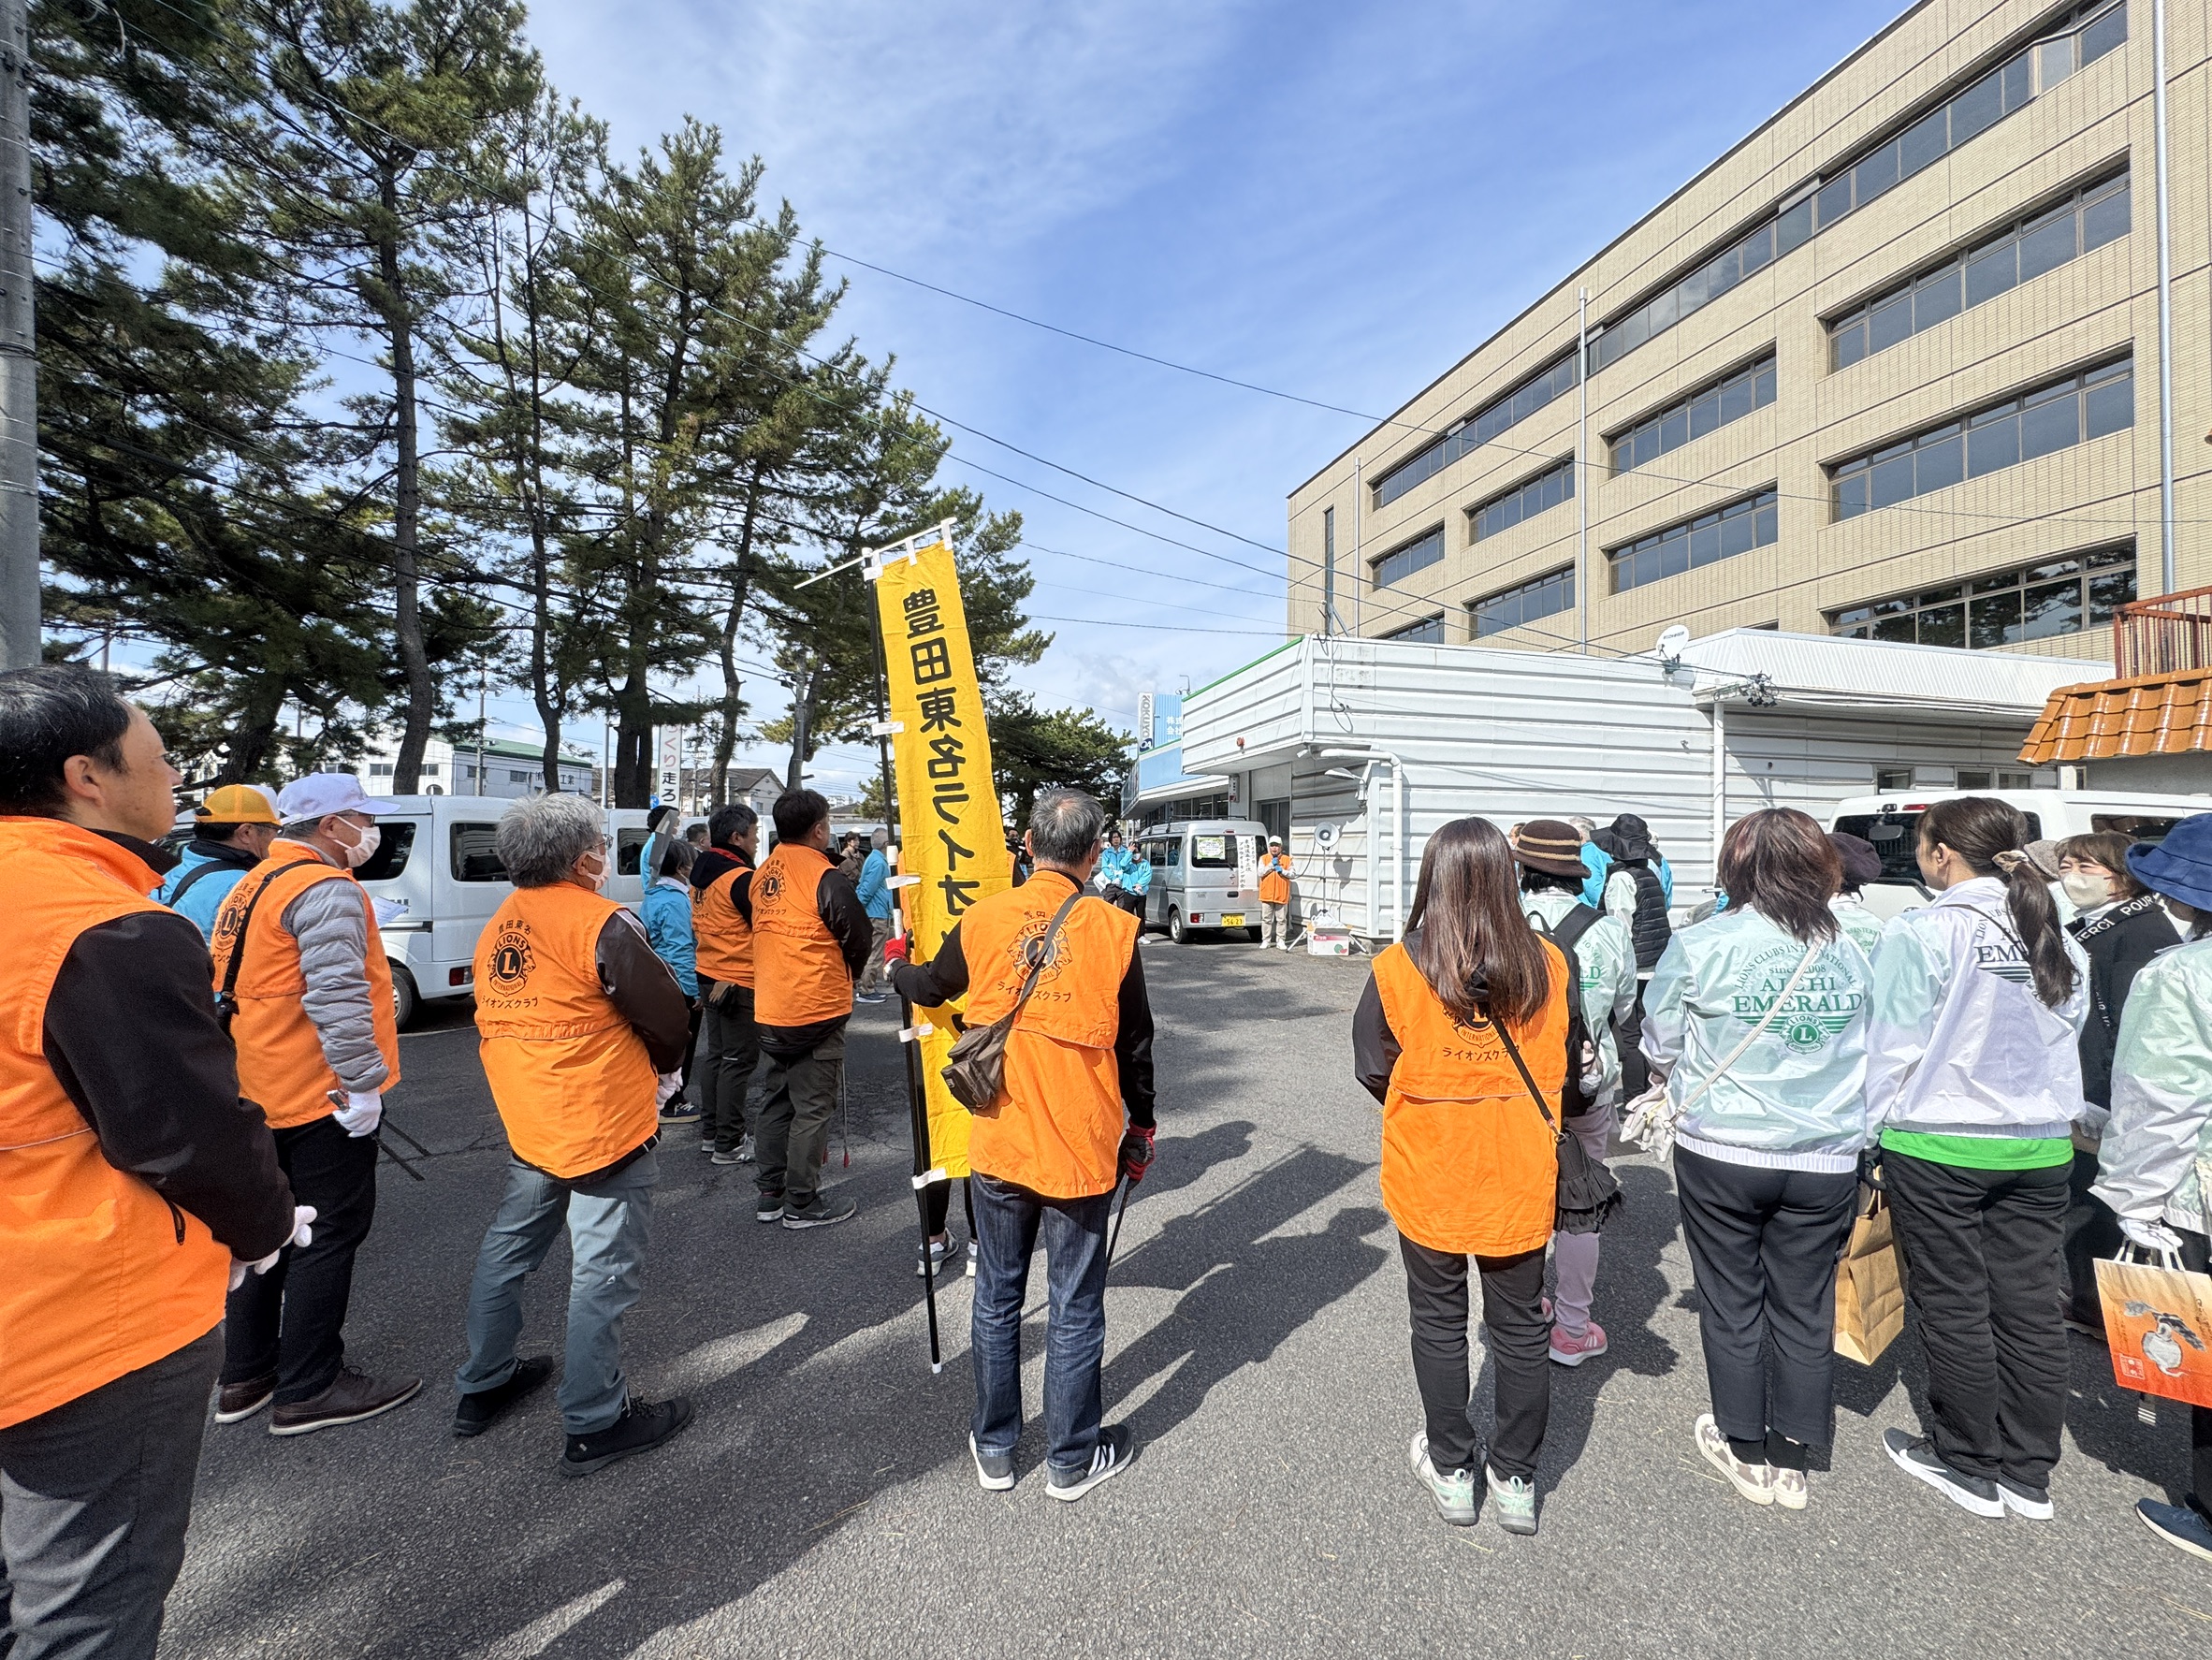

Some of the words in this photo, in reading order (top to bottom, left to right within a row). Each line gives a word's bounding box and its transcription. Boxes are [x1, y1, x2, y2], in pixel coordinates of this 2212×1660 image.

[1142, 694, 1151, 737] KOKUYO
[498, 920, 531, 935] 豊田東名
[1026, 923, 1063, 939] LIOS
[498, 935, 527, 948] LIONS
[502, 952, 517, 973] L
[1734, 962, 1757, 990] LIONS
[1754, 945, 1785, 965] CLUBS
[997, 981, 1071, 1003] ライオズクラブ
[1731, 993, 1863, 1012] EMERALD
[1789, 1015, 1818, 1025] LIONS
[1460, 1028, 1498, 1041] INTERNATIONA
[1799, 1027, 1813, 1041] L
